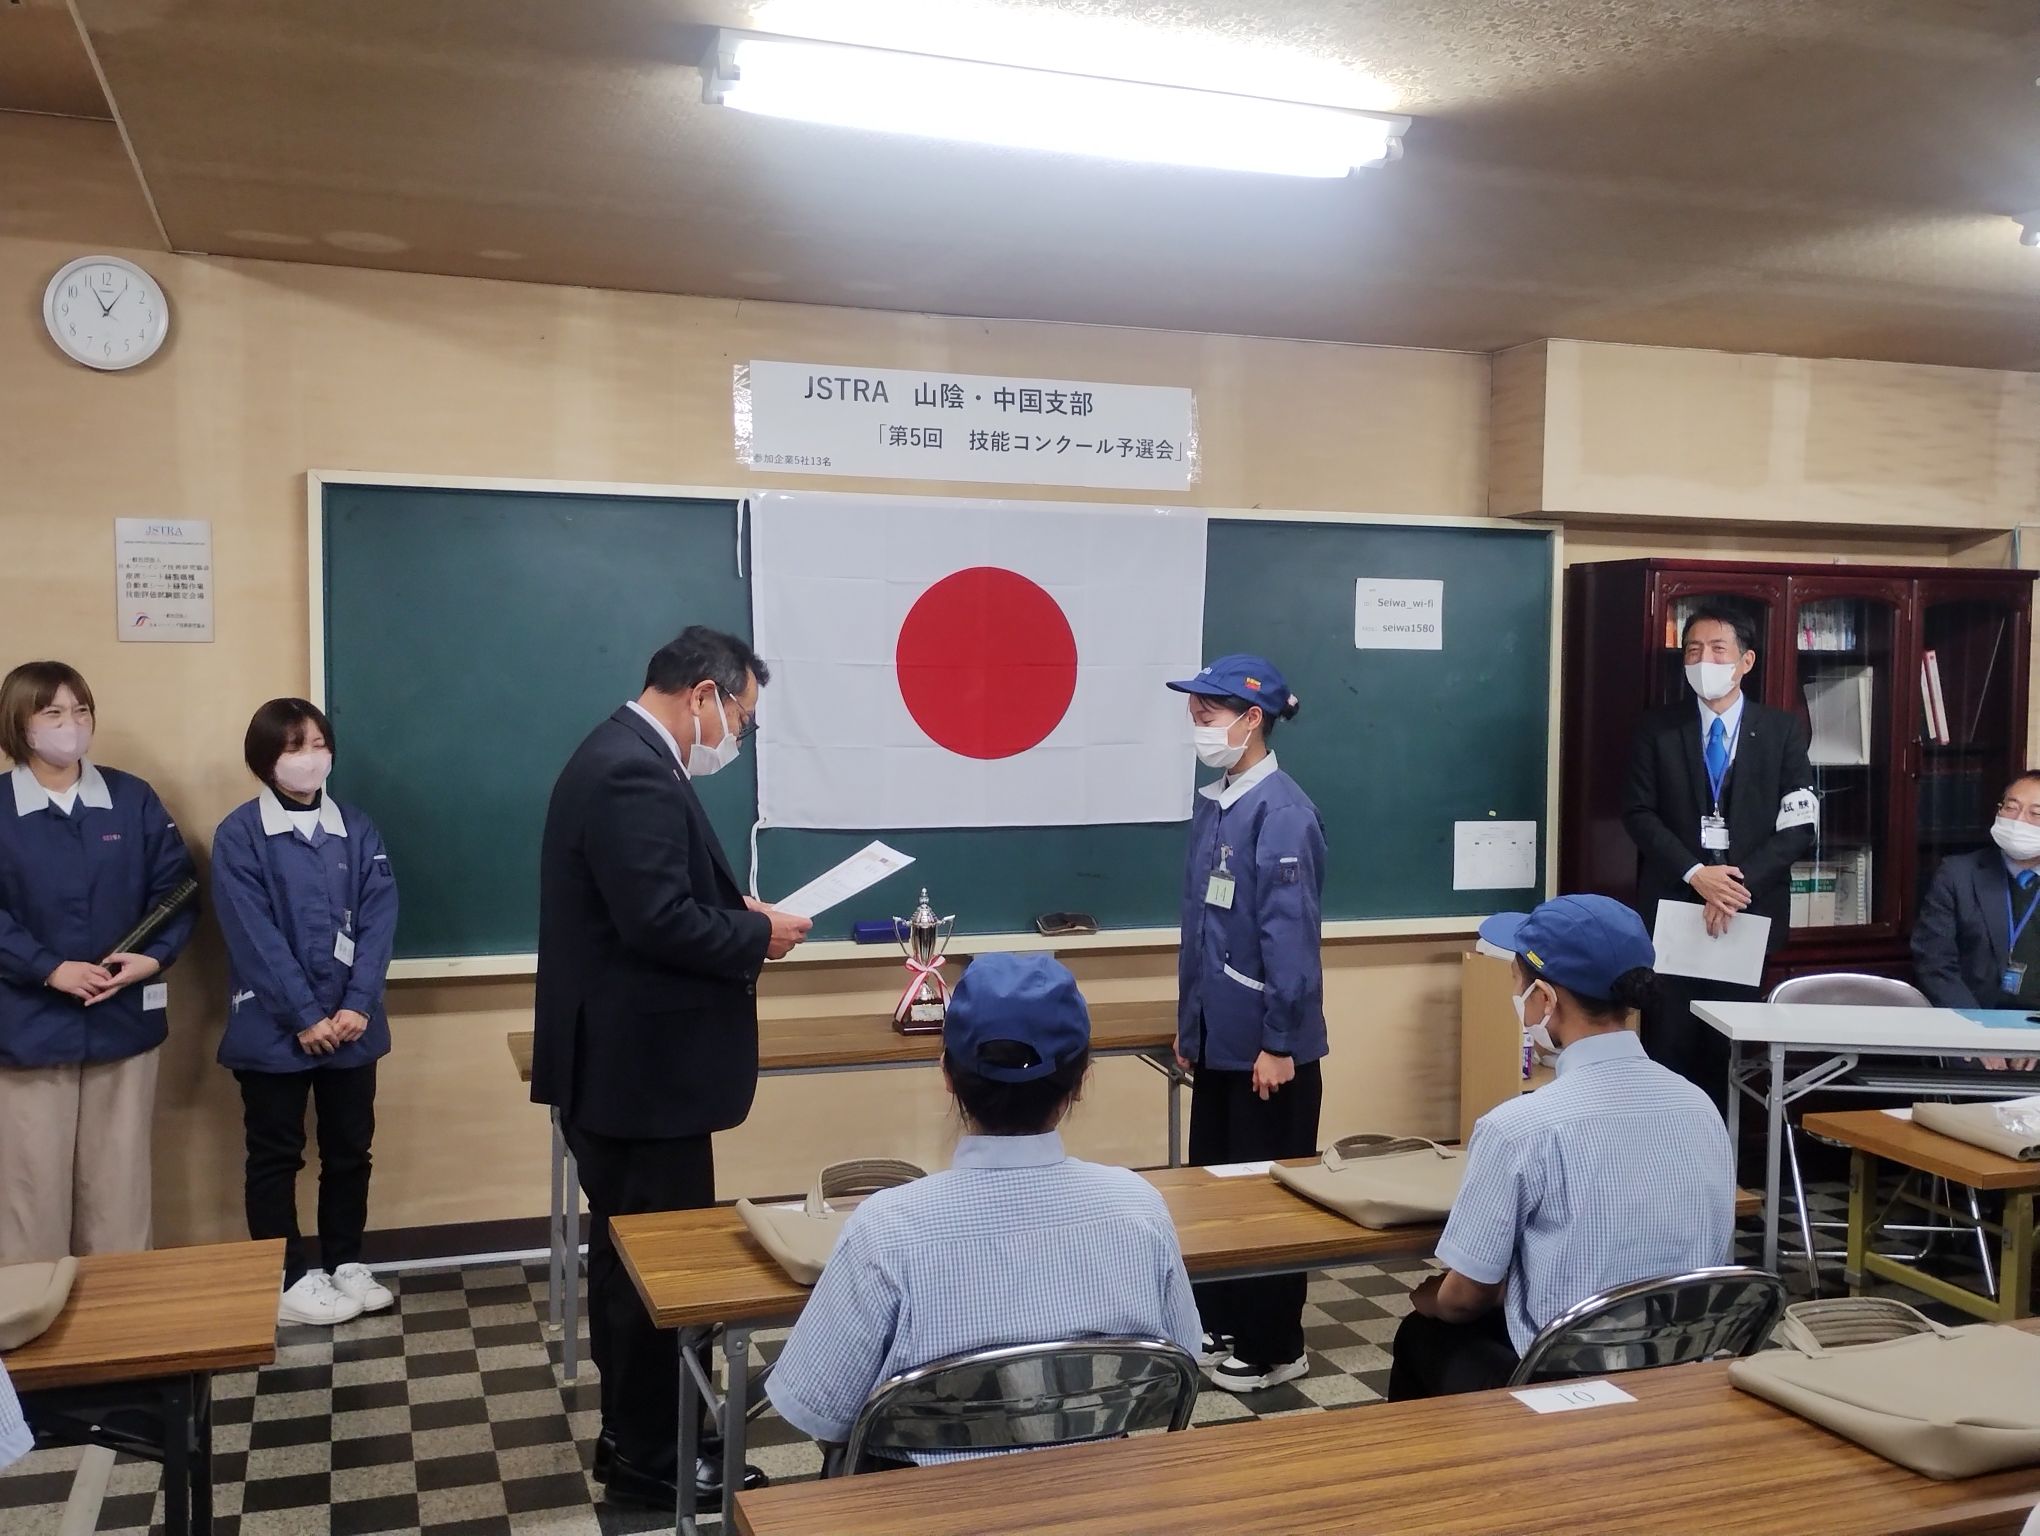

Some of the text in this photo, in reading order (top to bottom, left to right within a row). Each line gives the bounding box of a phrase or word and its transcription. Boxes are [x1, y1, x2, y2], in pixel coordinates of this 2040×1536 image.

[102, 271, 112, 287] 12
[68, 285, 78, 298] 10
[138, 290, 145, 304] 2
[61, 303, 69, 317] 9
[69, 322, 76, 337] 8
[103, 341, 112, 358] 6
[804, 375, 1094, 417] JSTRA 山陰・中国支部
[879, 423, 1182, 462] 「第5回 技能コンクール予選会」
[754, 454, 832, 467] 参加企業5社13名
[145, 526, 183, 537] JSTRA
[1382, 624, 1435, 633] seiwa1580
[1557, 1391, 1596, 1405] 10
